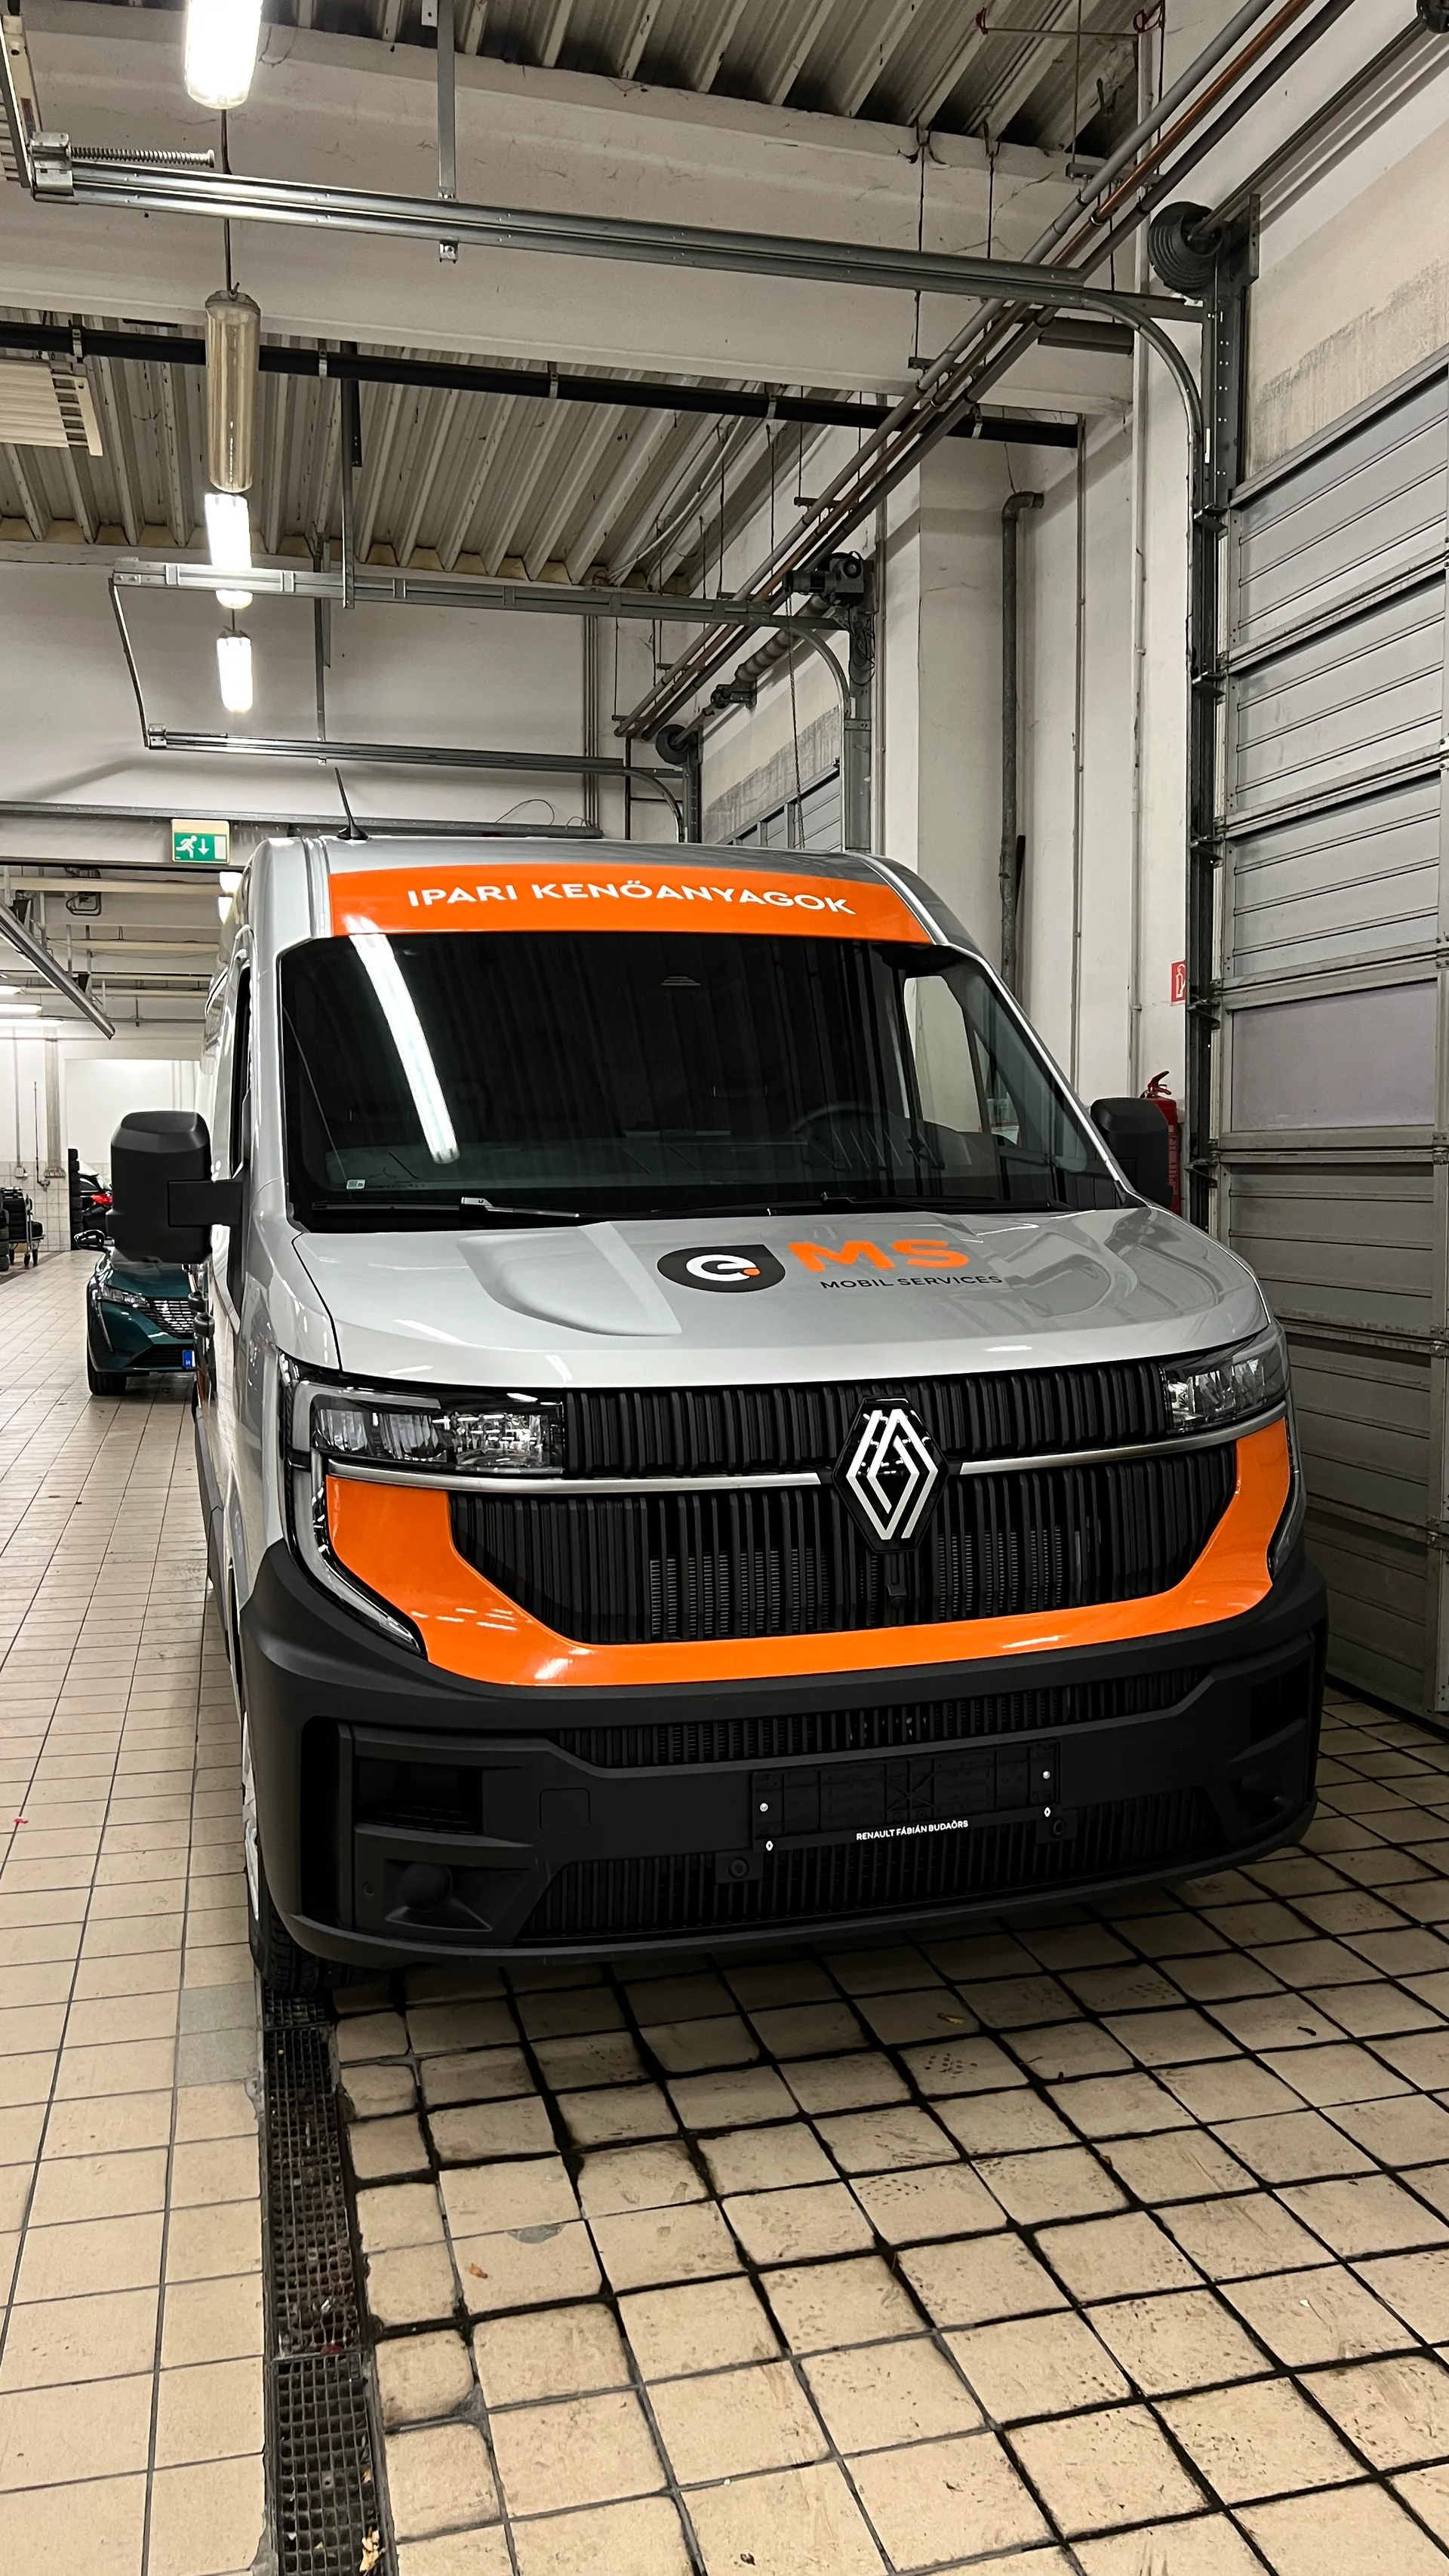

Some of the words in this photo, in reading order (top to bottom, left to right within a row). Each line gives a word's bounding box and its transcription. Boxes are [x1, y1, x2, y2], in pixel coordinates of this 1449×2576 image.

[408, 885, 518, 906] IPARI
[787, 1239, 970, 1272] MS
[820, 1279, 894, 1289] MOBIL
[897, 1276, 1004, 1286] SERVICES
[856, 1829, 896, 1841] RENAULT
[896, 1824, 928, 1836] FÁBIÁN
